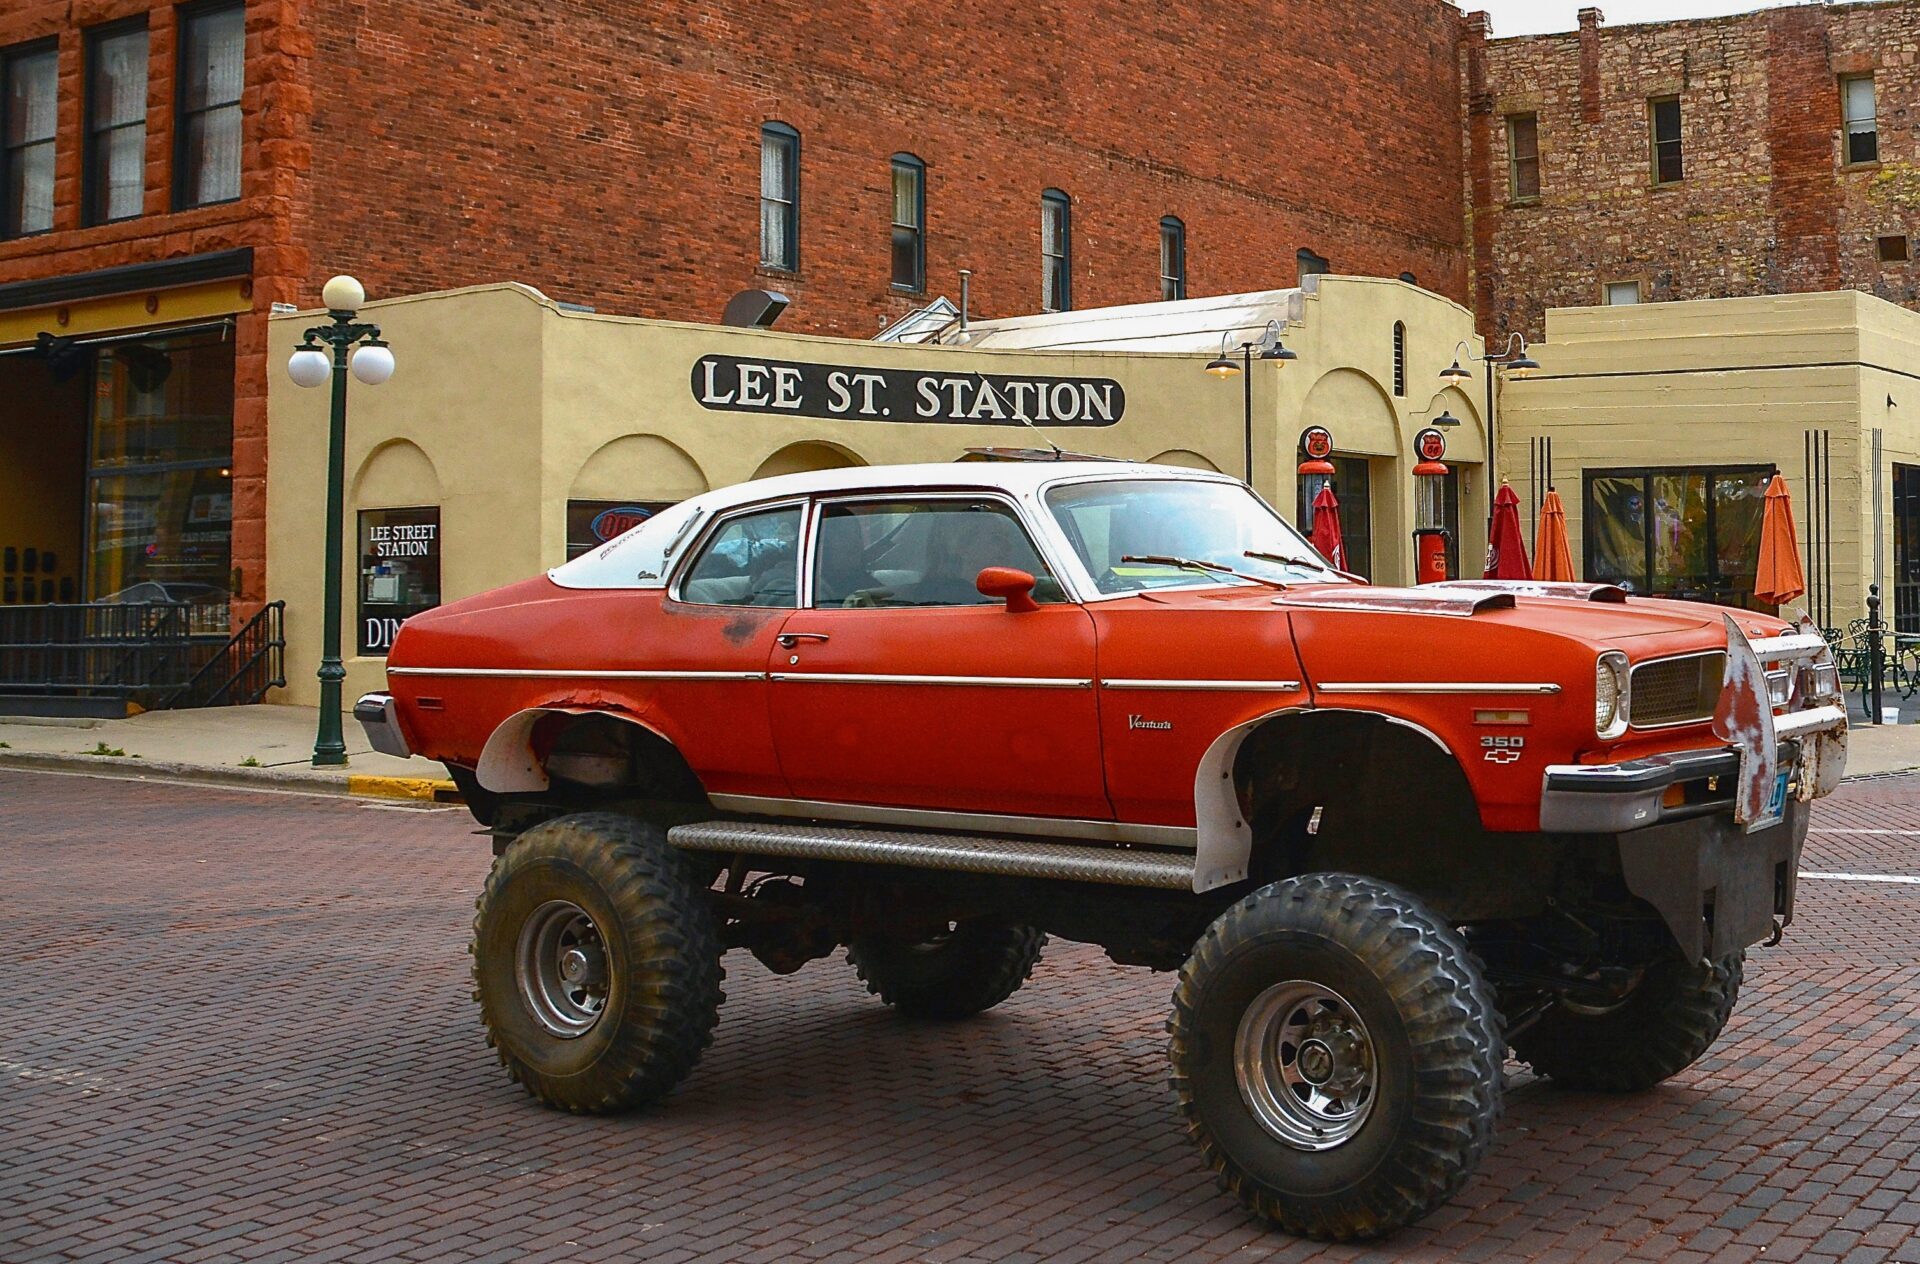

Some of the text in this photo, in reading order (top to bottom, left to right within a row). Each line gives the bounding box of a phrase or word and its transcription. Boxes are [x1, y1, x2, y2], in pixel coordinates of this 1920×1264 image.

[701, 361, 1114, 424] LEE ST. STATION
[1427, 445, 1440, 454] 66
[370, 525, 436, 541] LEE STREET
[599, 513, 645, 539] OP
[377, 541, 428, 557] STATION
[1128, 714, 1171, 730] Ventura
[1480, 736, 1524, 747] 350
